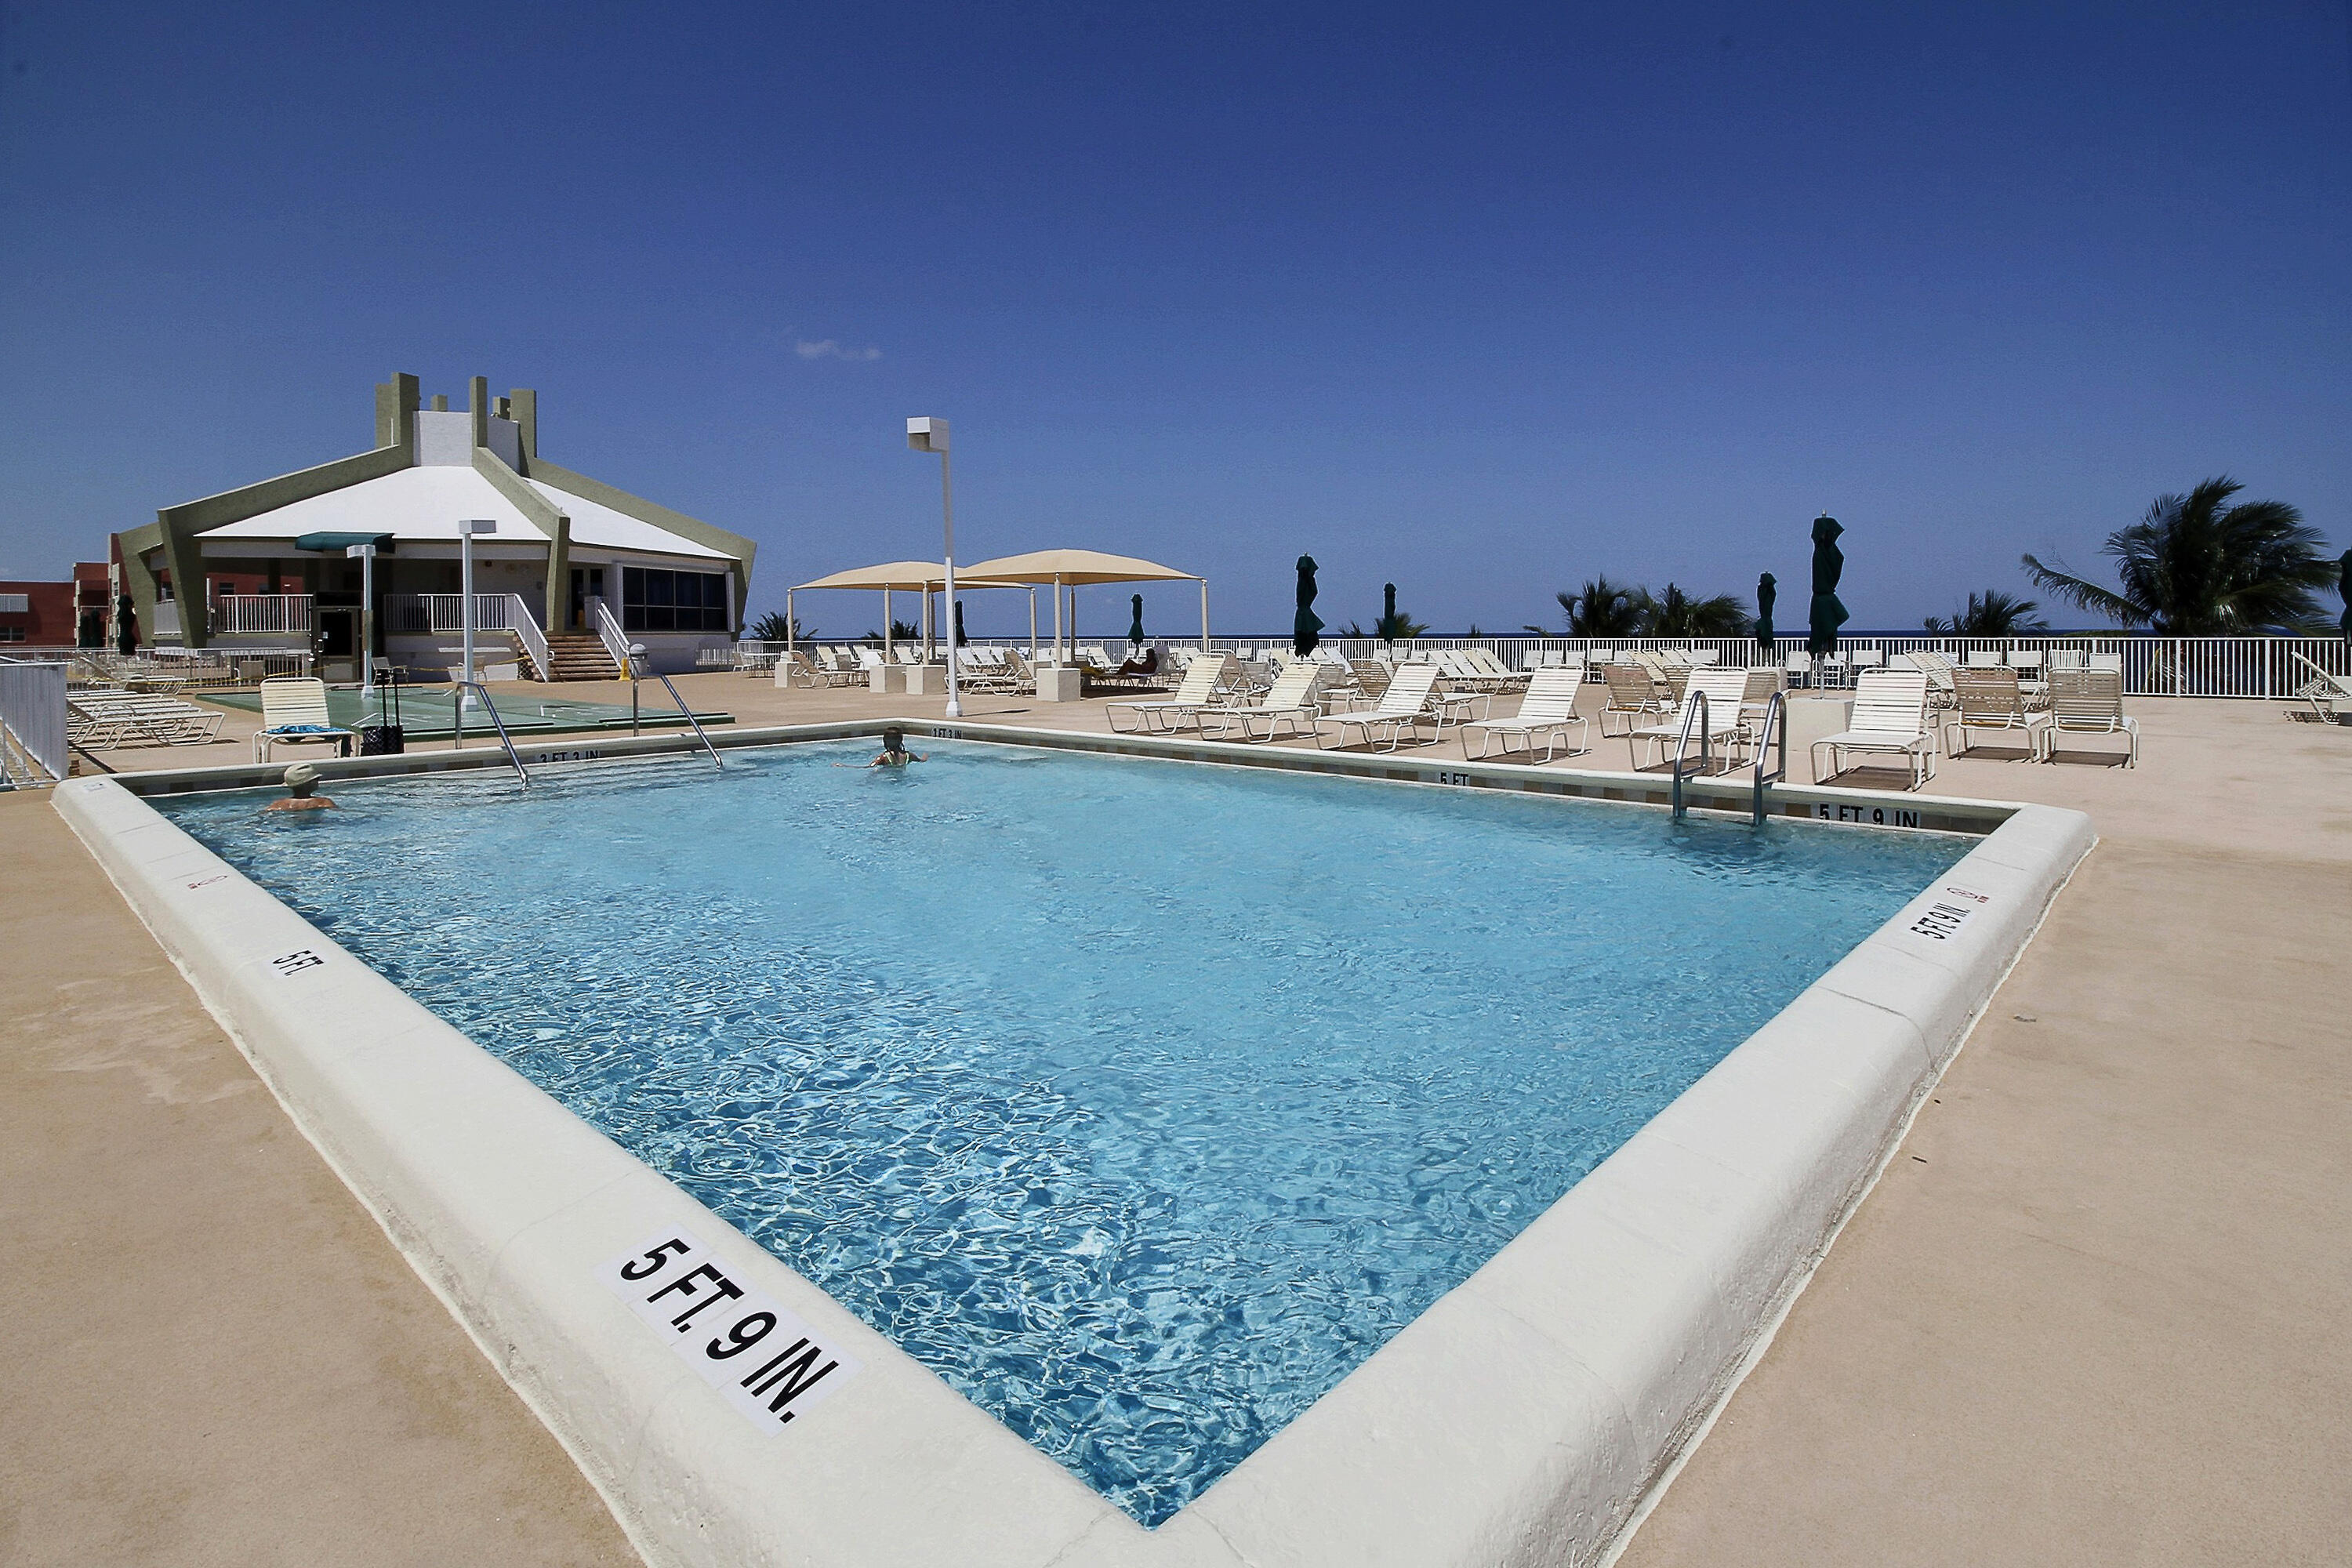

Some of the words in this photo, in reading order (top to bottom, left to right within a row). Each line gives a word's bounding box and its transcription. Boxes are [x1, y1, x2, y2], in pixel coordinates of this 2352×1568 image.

[552, 752, 568, 762] FT
[586, 750, 599, 760] IN
[1440, 772, 1447, 785] 5
[1453, 773, 1469, 786] FT
[1819, 804, 1831, 820] 5
[1838, 804, 1864, 823] FT
[1872, 808, 1884, 826] 9
[1895, 811, 1918, 829] IN
[1928, 912, 1962, 923] 9
[1911, 926, 1946, 939] 5
[273, 950, 312, 964] 5
[620, 1238, 691, 1281] 5
[646, 1262, 745, 1334] FT.
[706, 1311, 778, 1360] 9
[739, 1337, 840, 1424] IN.
